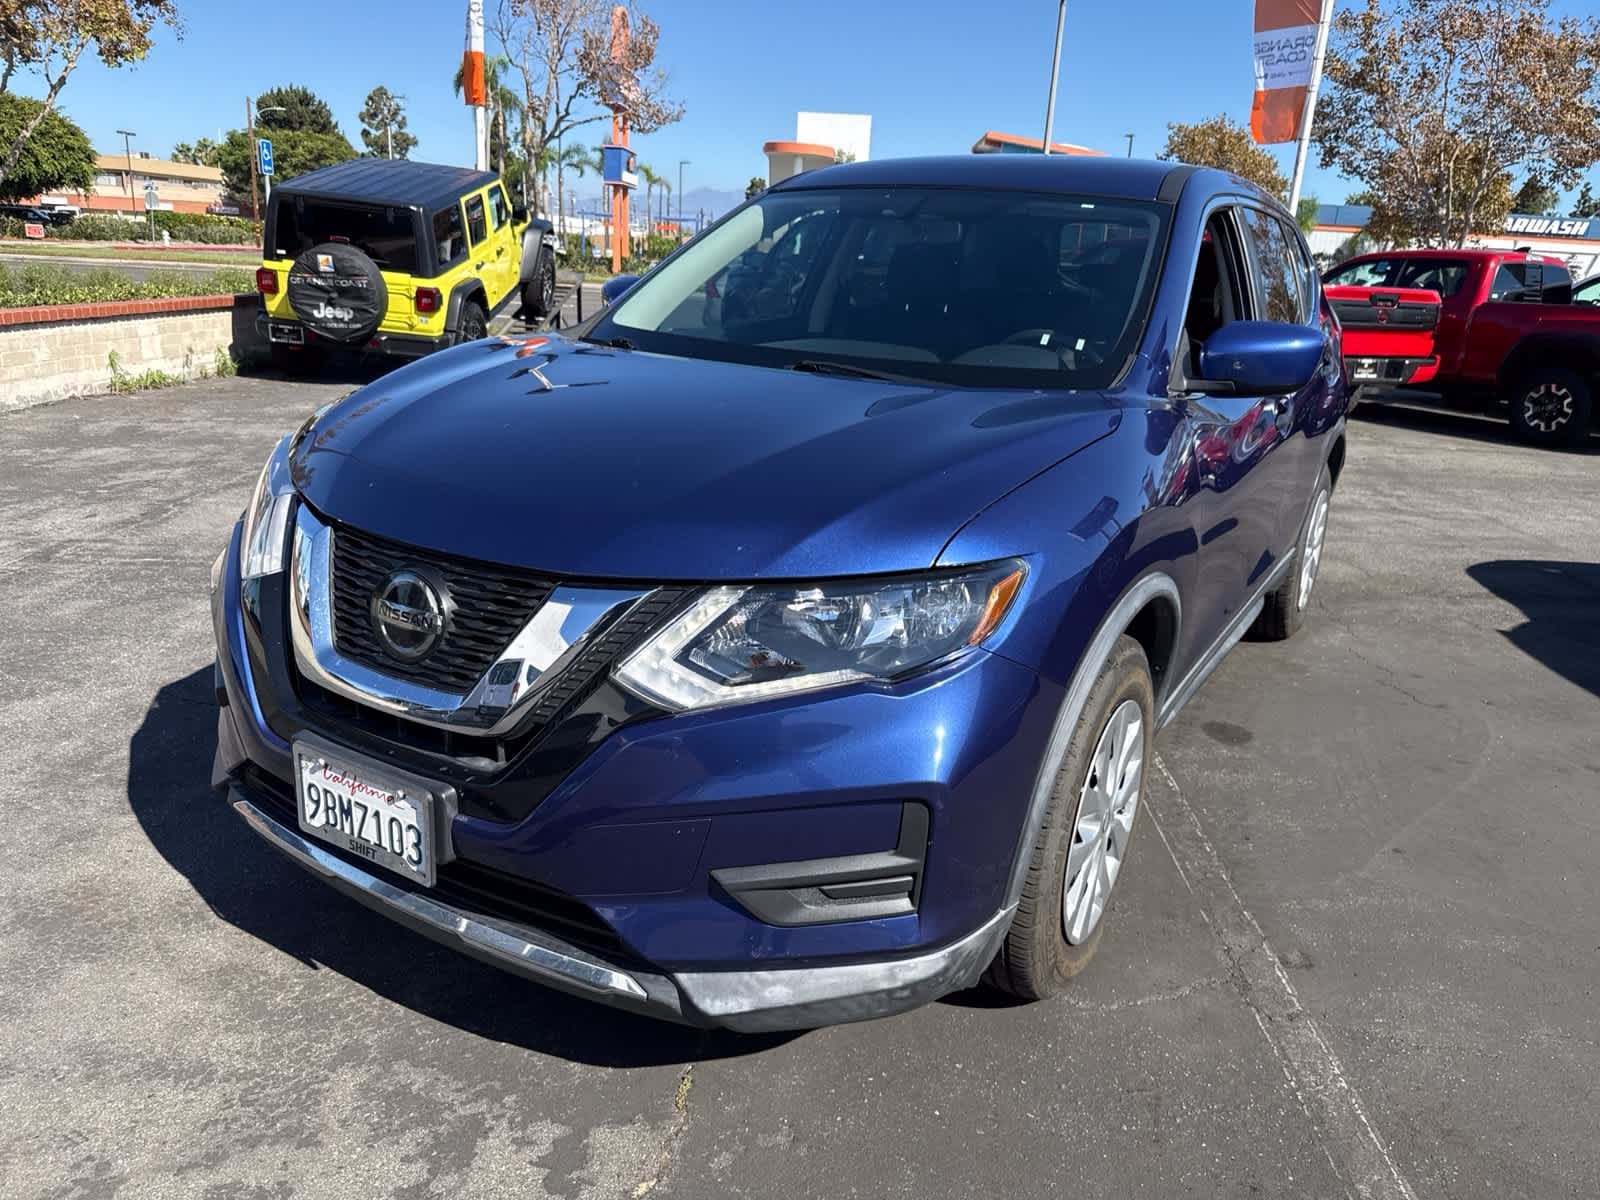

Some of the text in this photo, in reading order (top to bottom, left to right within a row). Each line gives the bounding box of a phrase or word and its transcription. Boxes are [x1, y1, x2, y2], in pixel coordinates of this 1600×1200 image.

[313, 302, 354, 322] Jeep
[378, 602, 434, 629] NISSAN
[320, 761, 395, 804] California
[307, 782, 422, 866] 9BMZ103
[349, 839, 377, 860] SHIFT
